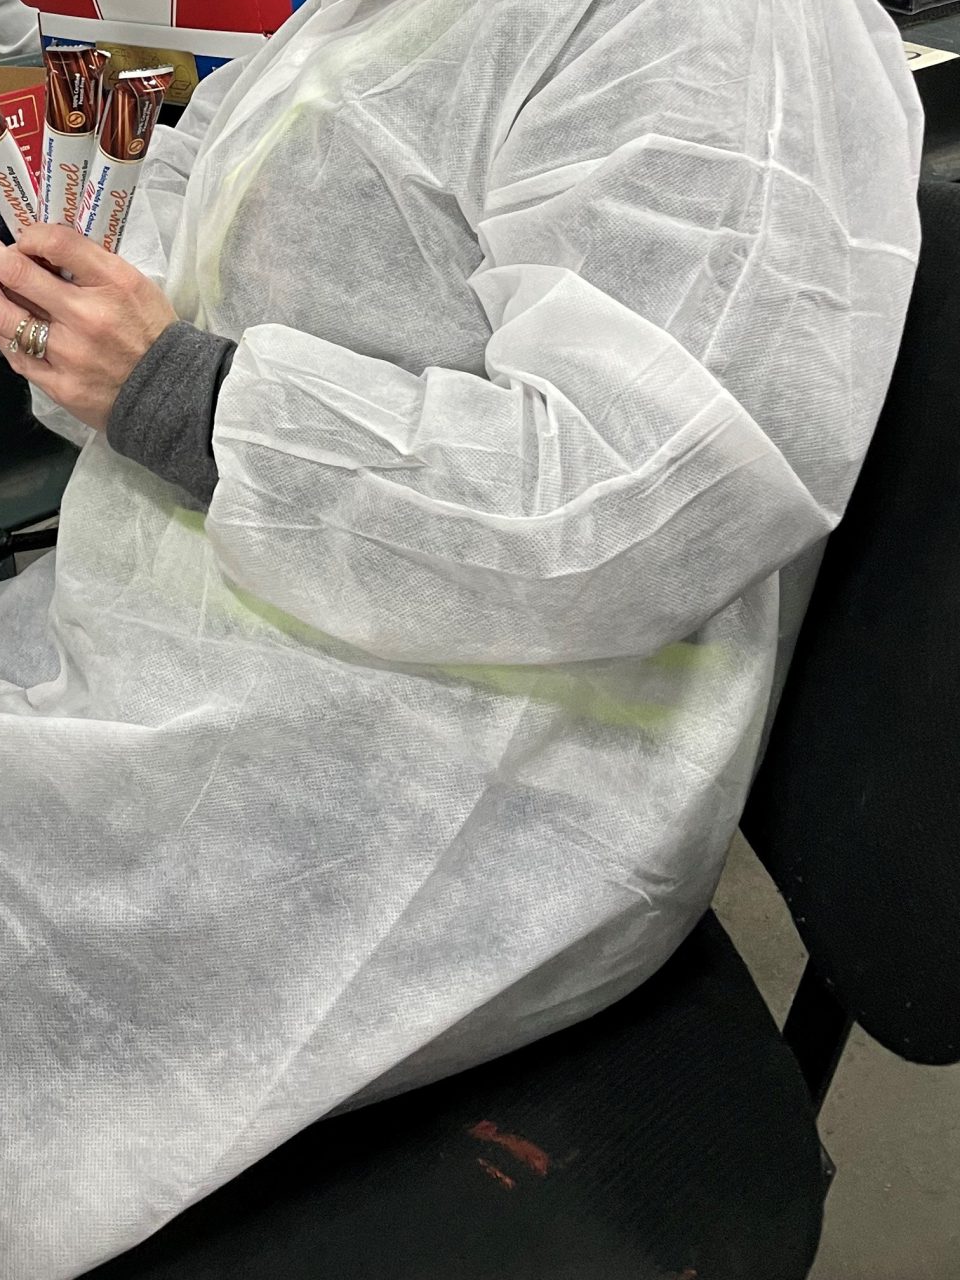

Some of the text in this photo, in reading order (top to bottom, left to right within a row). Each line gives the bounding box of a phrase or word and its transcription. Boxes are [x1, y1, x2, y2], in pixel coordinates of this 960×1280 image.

[5, 109, 25, 130] u!
[12, 175, 29, 202] Chocolate
[59, 163, 79, 224] aramel
[103, 190, 127, 252] aramel
